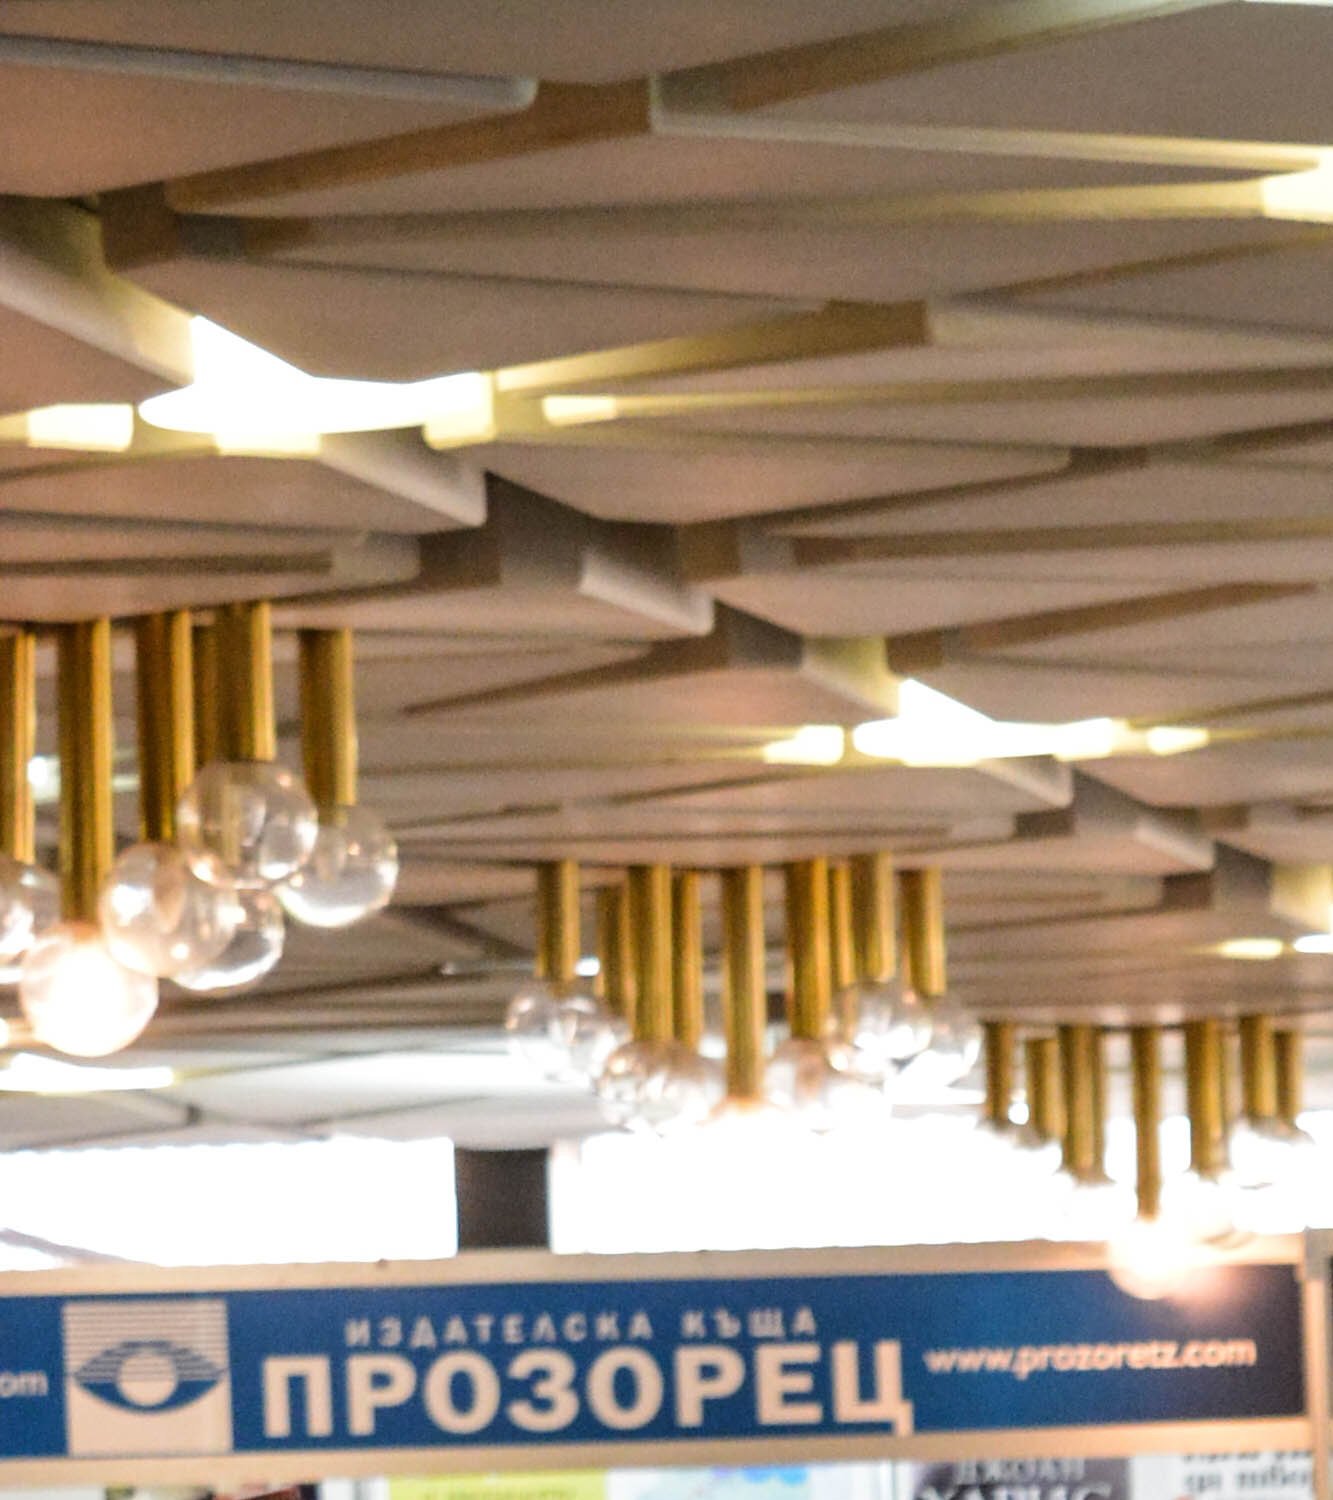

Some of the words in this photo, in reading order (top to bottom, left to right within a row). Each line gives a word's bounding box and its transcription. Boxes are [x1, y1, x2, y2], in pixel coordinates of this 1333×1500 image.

[345, 1310, 654, 1350] ИЗДАТЕЛСКА
[681, 1306, 817, 1340] КЪЩА
[924, 1338, 1258, 1381] www.prozoretz.com
[262, 1337, 914, 1438] ПРОЗОРЕЦ
